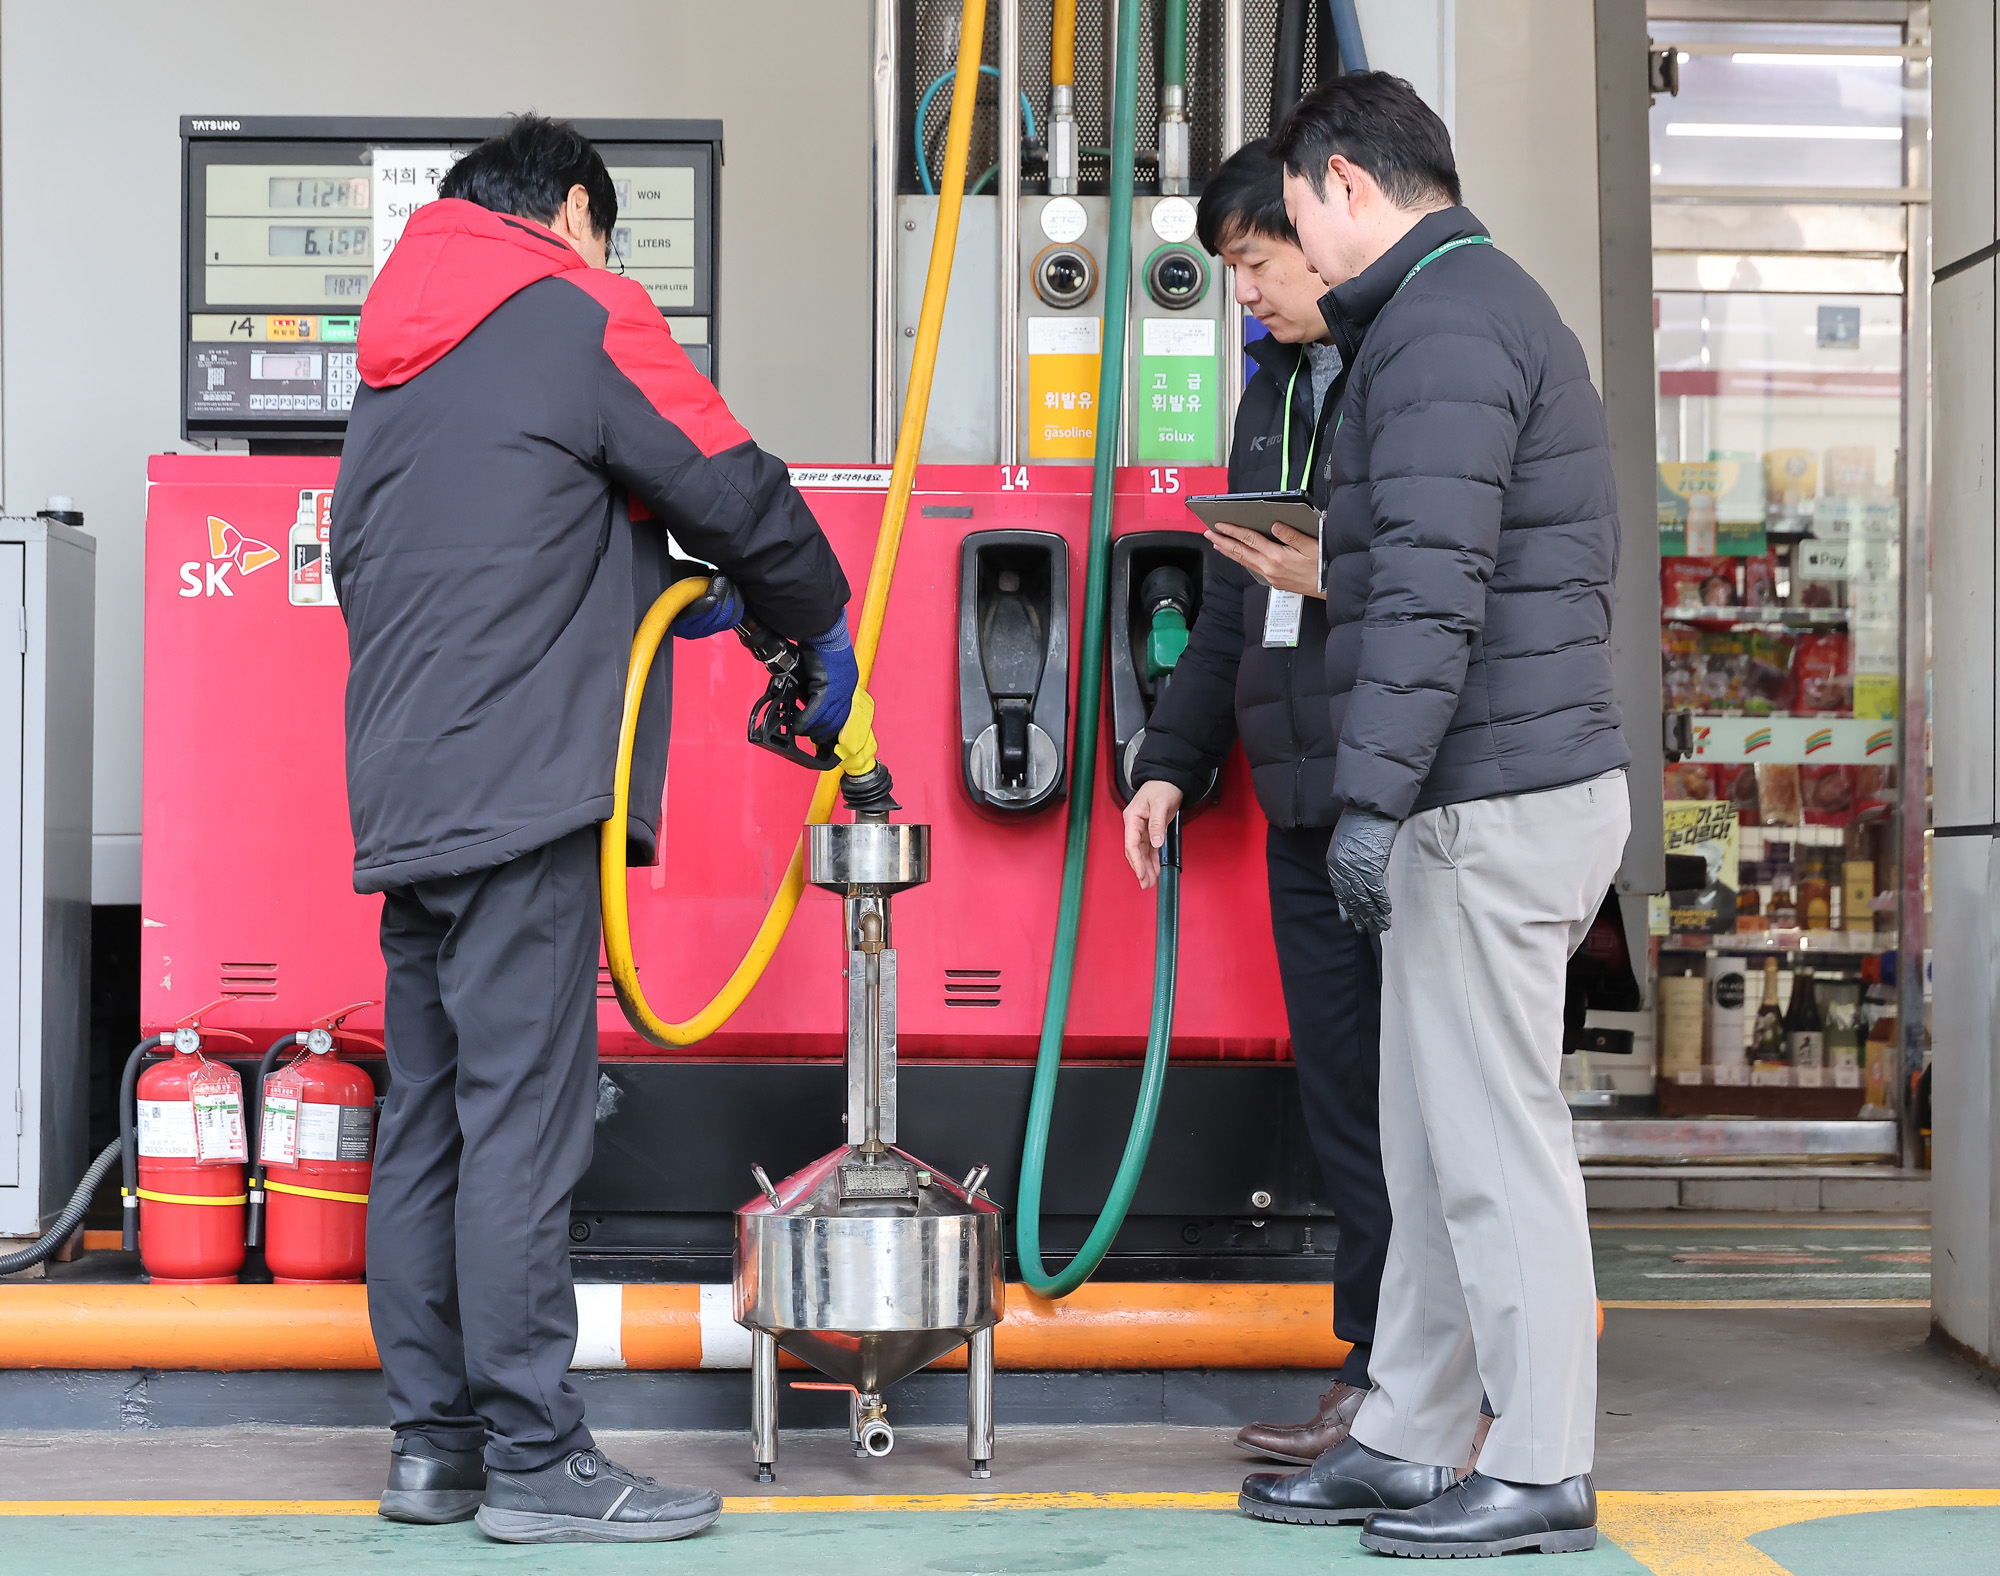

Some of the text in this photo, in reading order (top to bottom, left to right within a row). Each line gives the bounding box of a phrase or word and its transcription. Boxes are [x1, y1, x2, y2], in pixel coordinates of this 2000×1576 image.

[192, 120, 241, 131] TATSUNO
[382, 168, 416, 186] 저희
[637, 190, 661, 200] WON
[637, 239, 671, 249] LITERS
[655, 284, 668, 292] PER
[670, 284, 688, 292] LITER
[229, 317, 255, 338] 14
[332, 355, 353, 365] 7 8
[331, 370, 353, 379] 4 5
[345, 385, 353, 394] 2
[251, 398, 263, 407] P1
[266, 398, 278, 407] P2
[280, 398, 292, 407] P3
[294, 398, 306, 407] P4
[308, 398, 321, 407] P5
[331, 398, 338, 408] 0
[1044, 391, 1093, 409] 휘발유
[1151, 394, 1202, 413] 휘발유
[1044, 425, 1093, 441] gasoline
[1158, 426, 1196, 442] solux
[1000, 466, 1030, 491] 14
[1149, 469, 1180, 493] 15
[178, 561, 235, 597] SK
